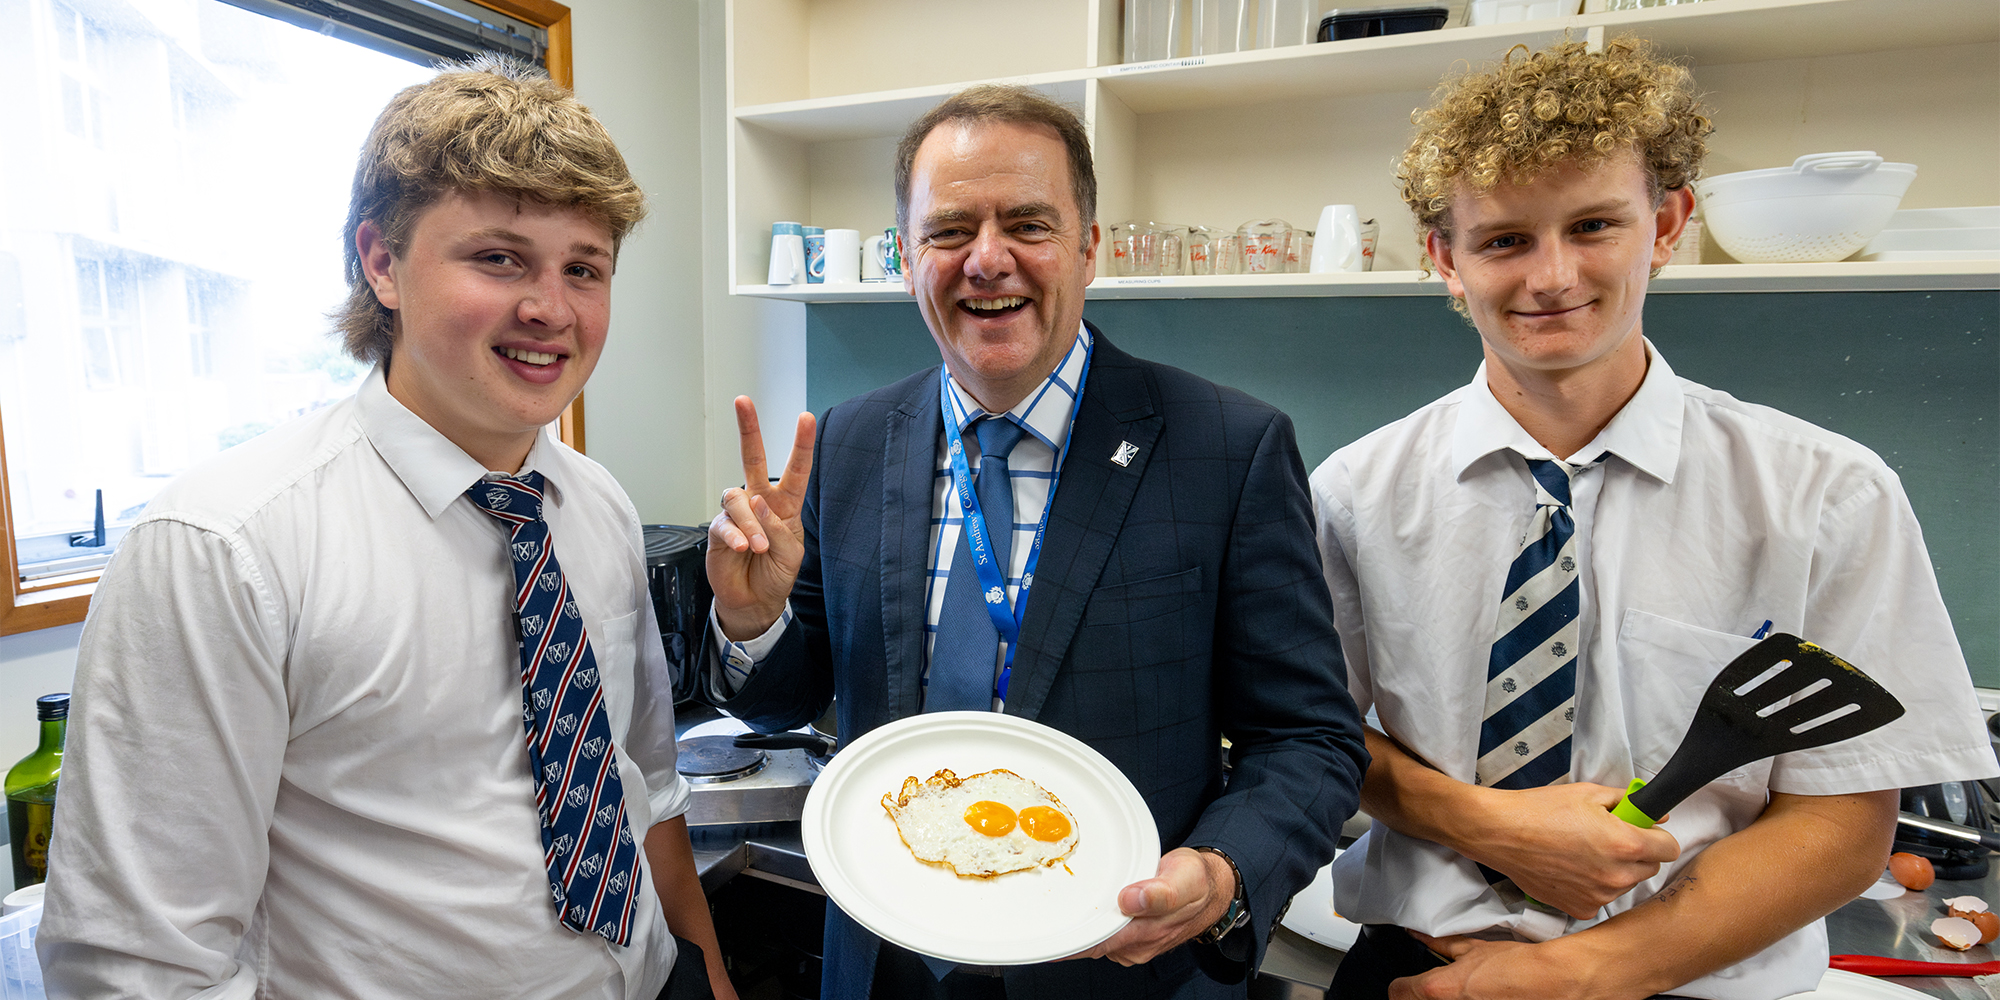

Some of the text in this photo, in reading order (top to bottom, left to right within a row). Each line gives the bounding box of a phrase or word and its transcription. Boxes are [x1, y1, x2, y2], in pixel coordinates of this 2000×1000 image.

[958, 473, 988, 565] St Andrew's College
[1034, 511, 1047, 550] College
